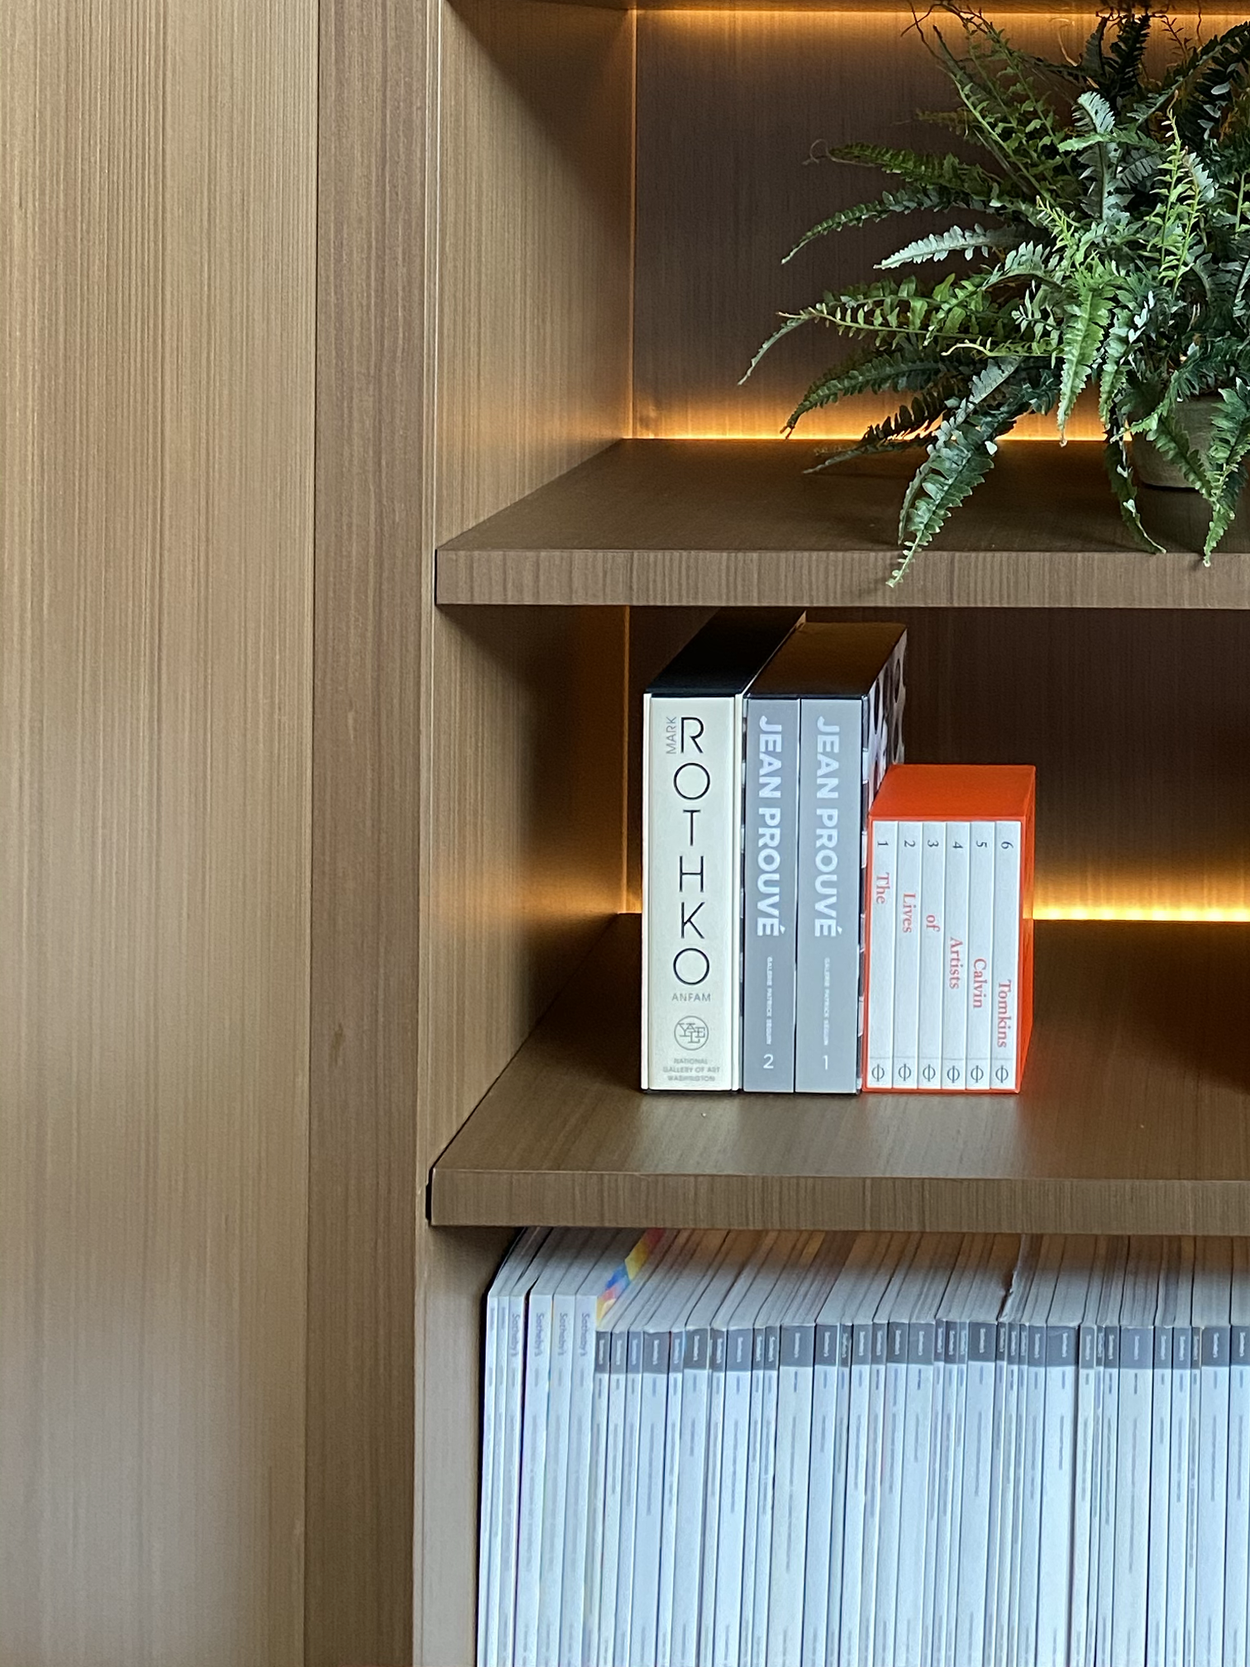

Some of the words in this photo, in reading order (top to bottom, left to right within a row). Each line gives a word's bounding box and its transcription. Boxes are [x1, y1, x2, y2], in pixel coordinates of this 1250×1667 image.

[666, 716, 677, 755] MARK
[758, 716, 782, 798] JEAN
[816, 716, 840, 799] JEAN
[673, 716, 711, 985] ROTHKO
[904, 840, 916, 848] 2
[953, 841, 963, 849] 4
[1001, 841, 1014, 849] 6
[756, 807, 786, 937] PROUVÉ
[814, 808, 843, 938] PROUVÉ
[876, 872, 890, 904] The
[903, 893, 916, 933] Lives
[926, 915, 940, 931] of
[950, 937, 963, 989] Artists
[672, 992, 711, 1002] ANFAM
[973, 958, 988, 1009] Calvin
[998, 980, 1011, 1048] Tomkins
[763, 1054, 774, 1069] 2
[824, 1055, 829, 1070] 1
